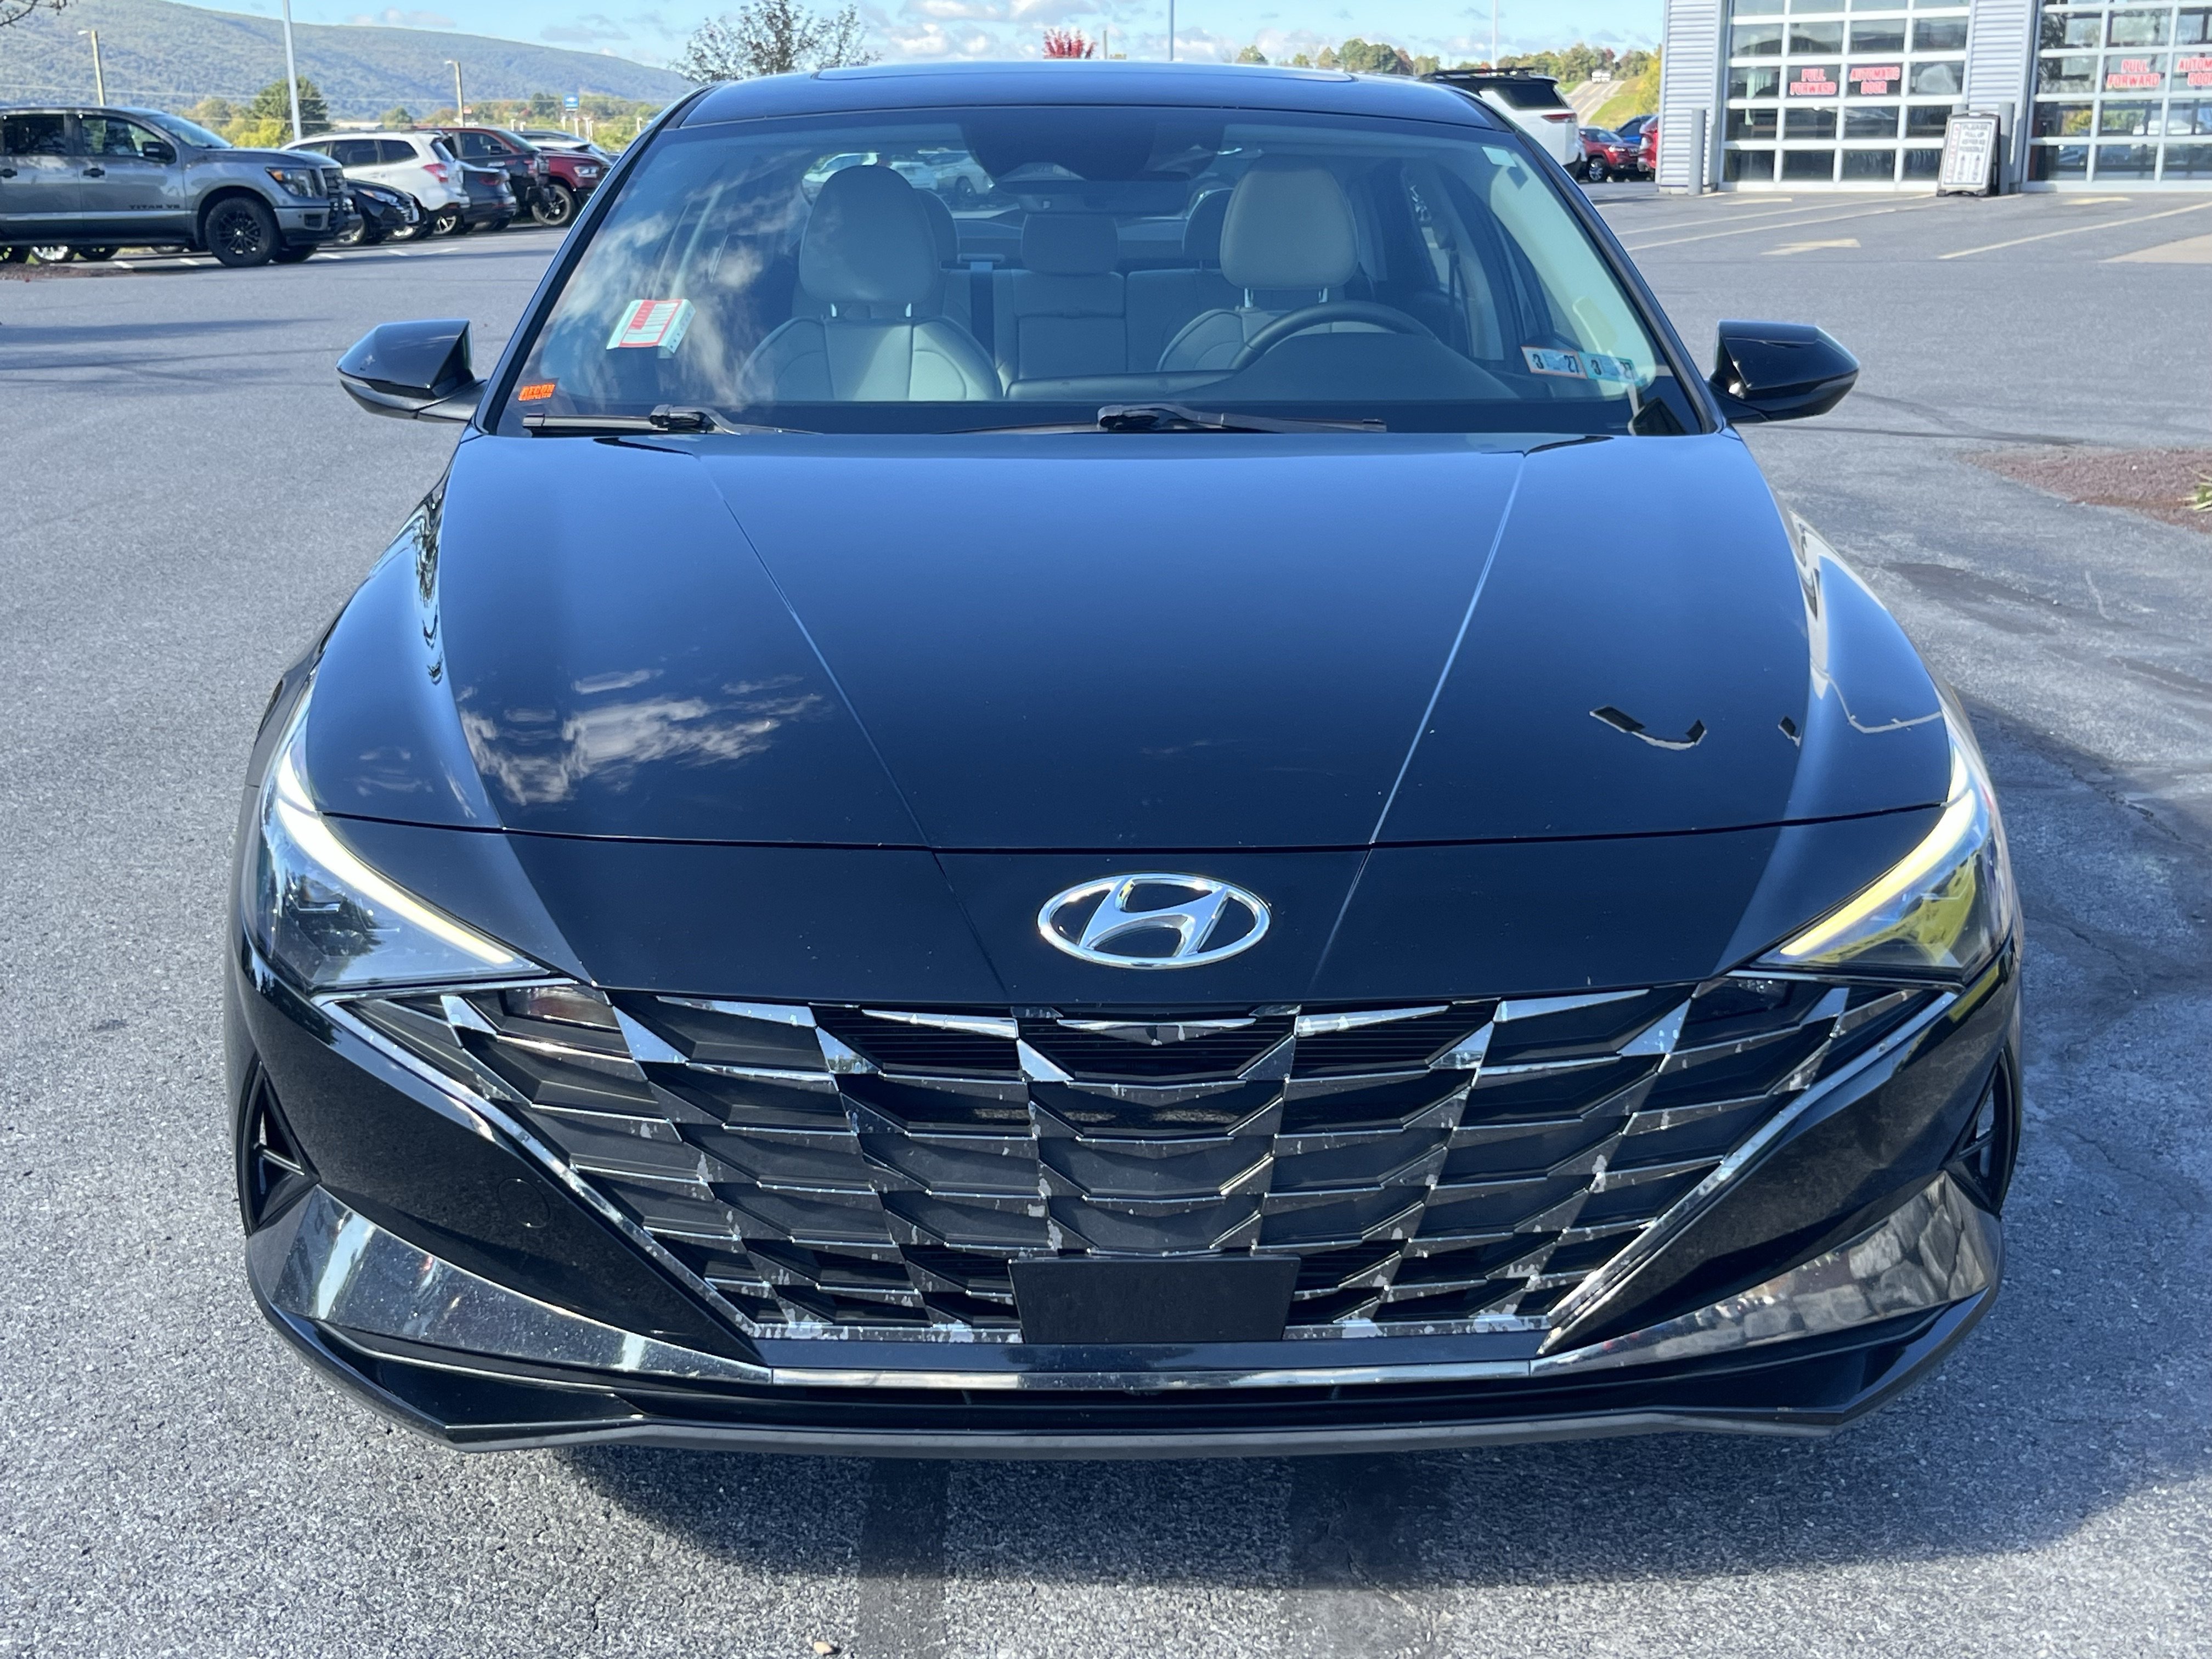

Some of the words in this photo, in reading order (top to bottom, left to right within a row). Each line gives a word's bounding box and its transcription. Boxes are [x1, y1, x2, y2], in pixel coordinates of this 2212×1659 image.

[2121, 59, 2149, 74] PULL
[1801, 69, 1826, 82] PULL
[2107, 74, 2161, 89] FORWARD
[1790, 82, 1837, 95] FORWARD
[1860, 81, 1887, 94] DOOR
[1532, 353, 1544, 369] 3
[1564, 355, 1580, 374] 27
[1591, 359, 1602, 376] 3
